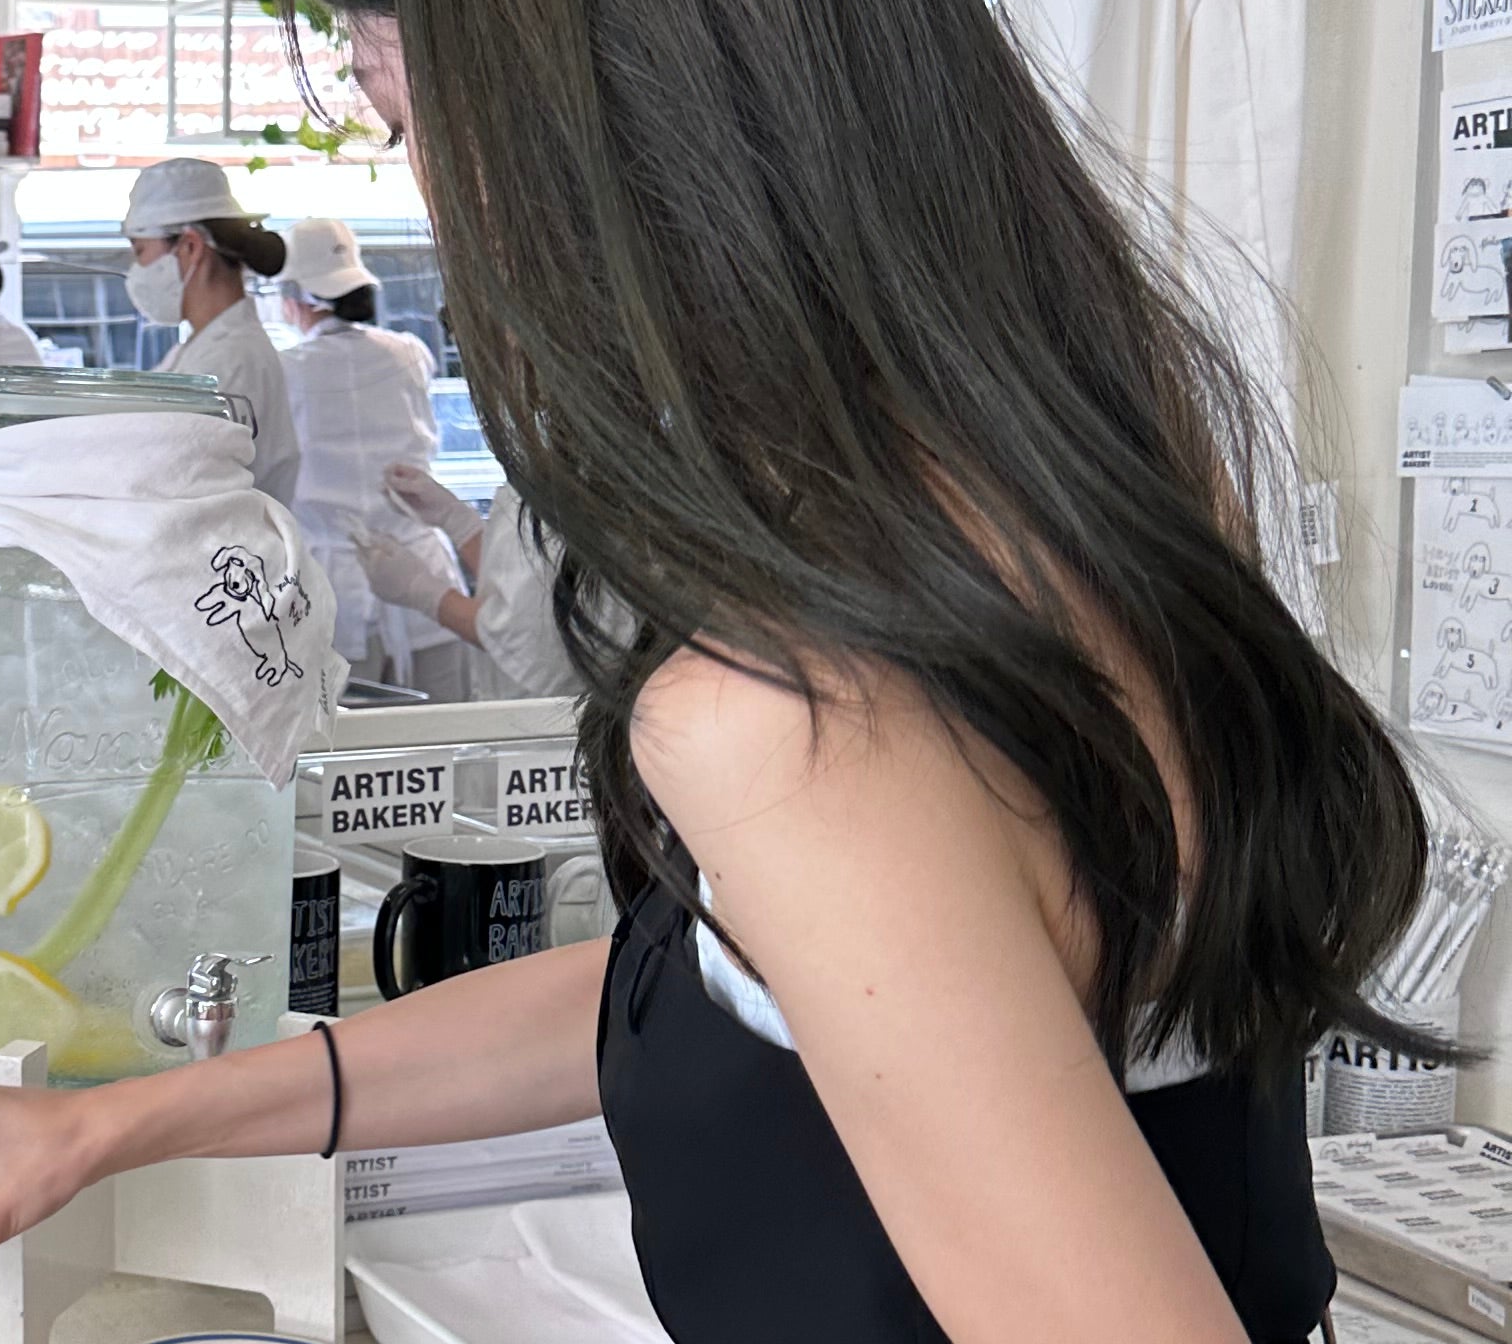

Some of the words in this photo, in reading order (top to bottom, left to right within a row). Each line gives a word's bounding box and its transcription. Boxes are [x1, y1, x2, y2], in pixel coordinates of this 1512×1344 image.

[1467, 653, 1476, 670] 5
[330, 765, 446, 801] ARTIST
[331, 801, 446, 834] BAKERY
